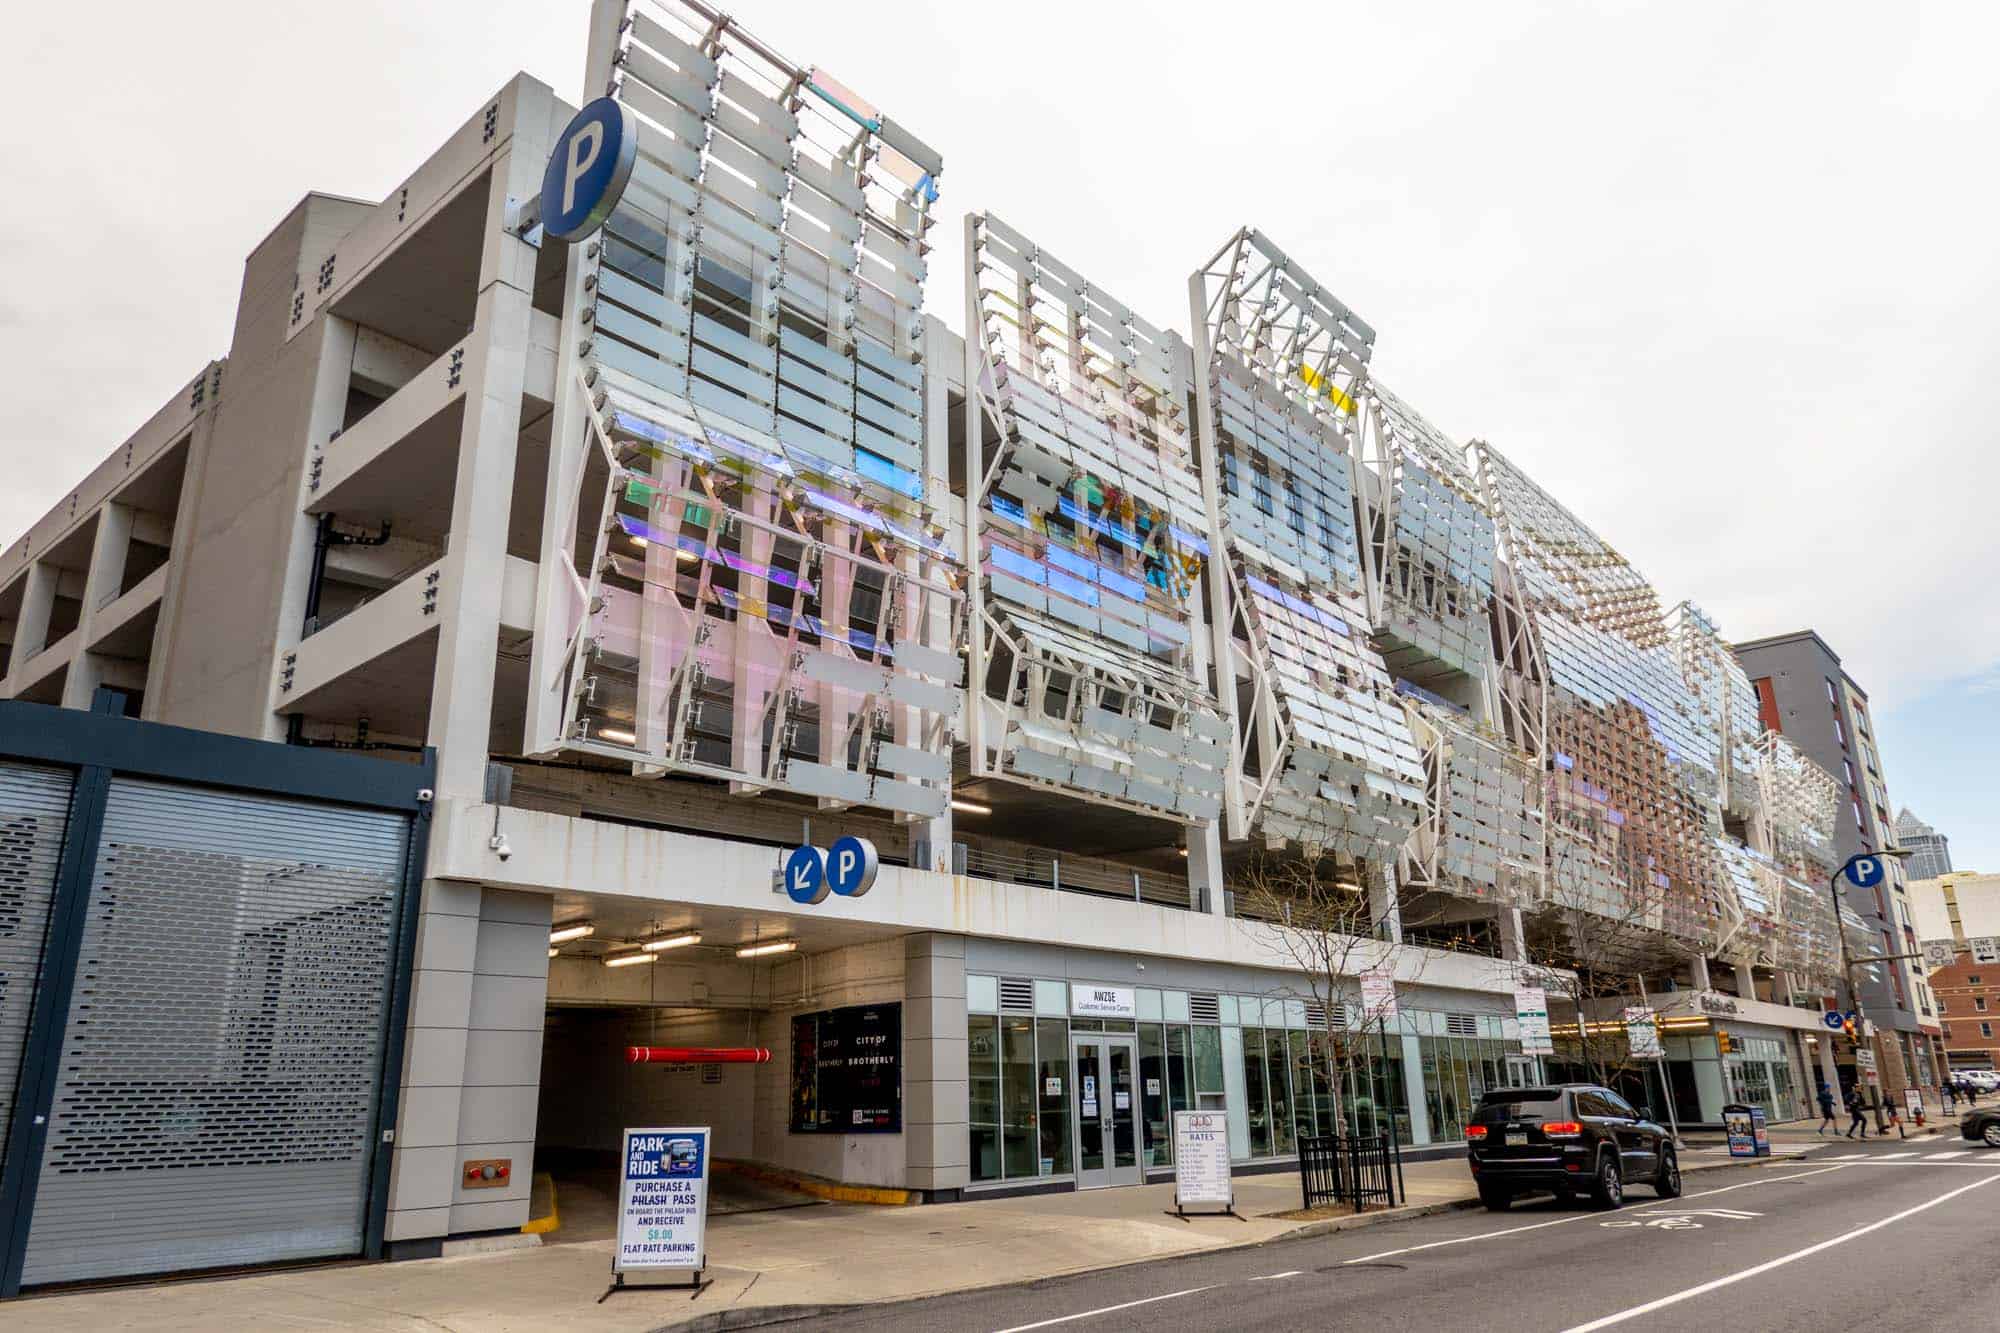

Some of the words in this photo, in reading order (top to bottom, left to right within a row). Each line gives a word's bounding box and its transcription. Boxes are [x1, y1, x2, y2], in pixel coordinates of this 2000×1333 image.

[562, 119, 604, 216] P
[839, 849, 856, 885] P
[1855, 859, 1874, 882] P
[856, 1036, 874, 1045] CITY
[875, 1035, 887, 1044] OF
[848, 1056, 895, 1066] BROTHERLY
[1190, 1133, 1215, 1141] RATES
[631, 1137, 664, 1152] PARK
[630, 1152, 645, 1161] AND
[628, 1160, 659, 1176] RIDE
[635, 1182, 683, 1193] PURCHASE
[684, 1181, 692, 1192] A
[632, 1195, 667, 1206] PHLASH
[672, 1194, 696, 1205] PASS
[654, 1207, 664, 1215] THE
[637, 1216, 654, 1226] AND
[655, 1216, 685, 1225] RECEIVE
[623, 1244, 642, 1254] FLAT
[643, 1244, 661, 1253] RATE
[663, 1243, 696, 1253] PARKING
